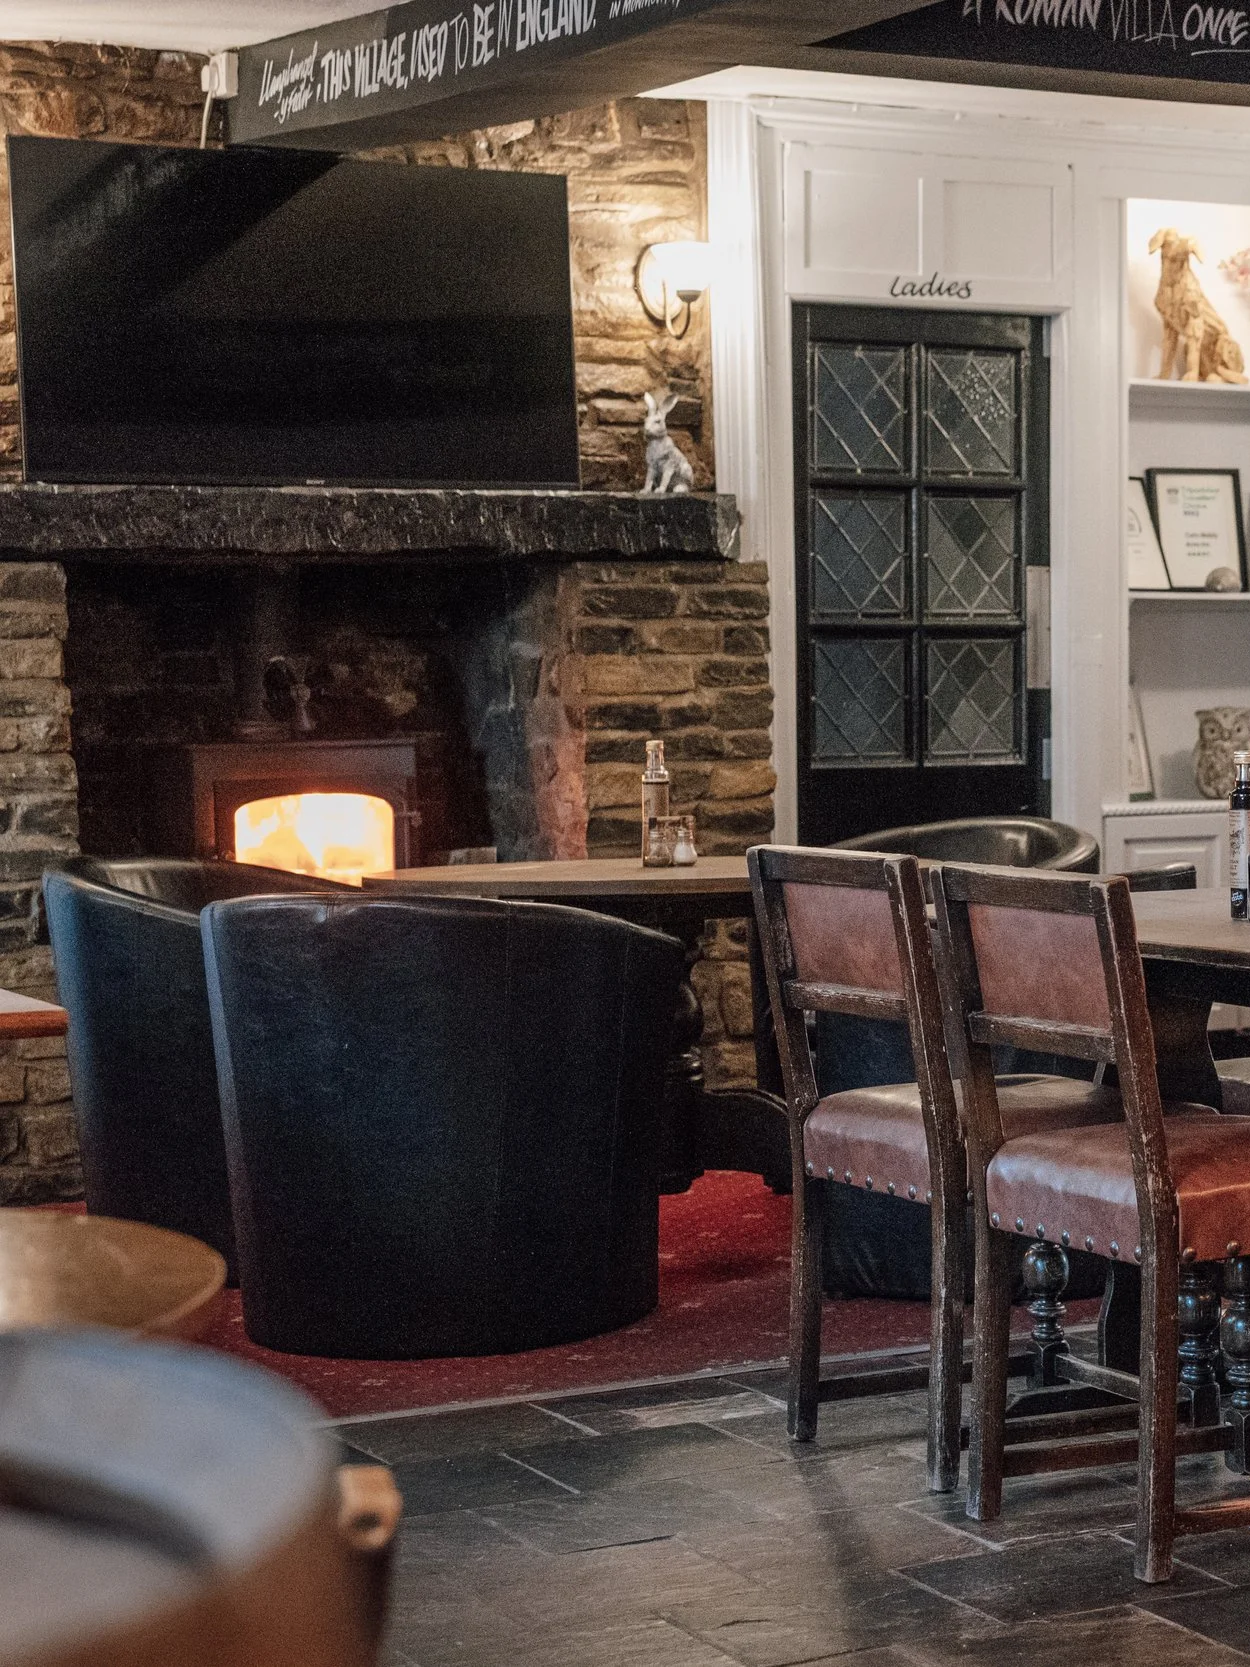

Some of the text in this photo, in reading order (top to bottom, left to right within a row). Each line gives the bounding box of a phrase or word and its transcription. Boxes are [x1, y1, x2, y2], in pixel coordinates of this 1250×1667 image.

[320, 48, 352, 103] THIS
[410, 20, 449, 83] USED
[449, 12, 469, 76] TO
[472, 2, 495, 67] BE
[497, 0, 513, 58] IN
[1109, 0, 1179, 50] VILLA
[1182, 3, 1249, 46] ONCE
